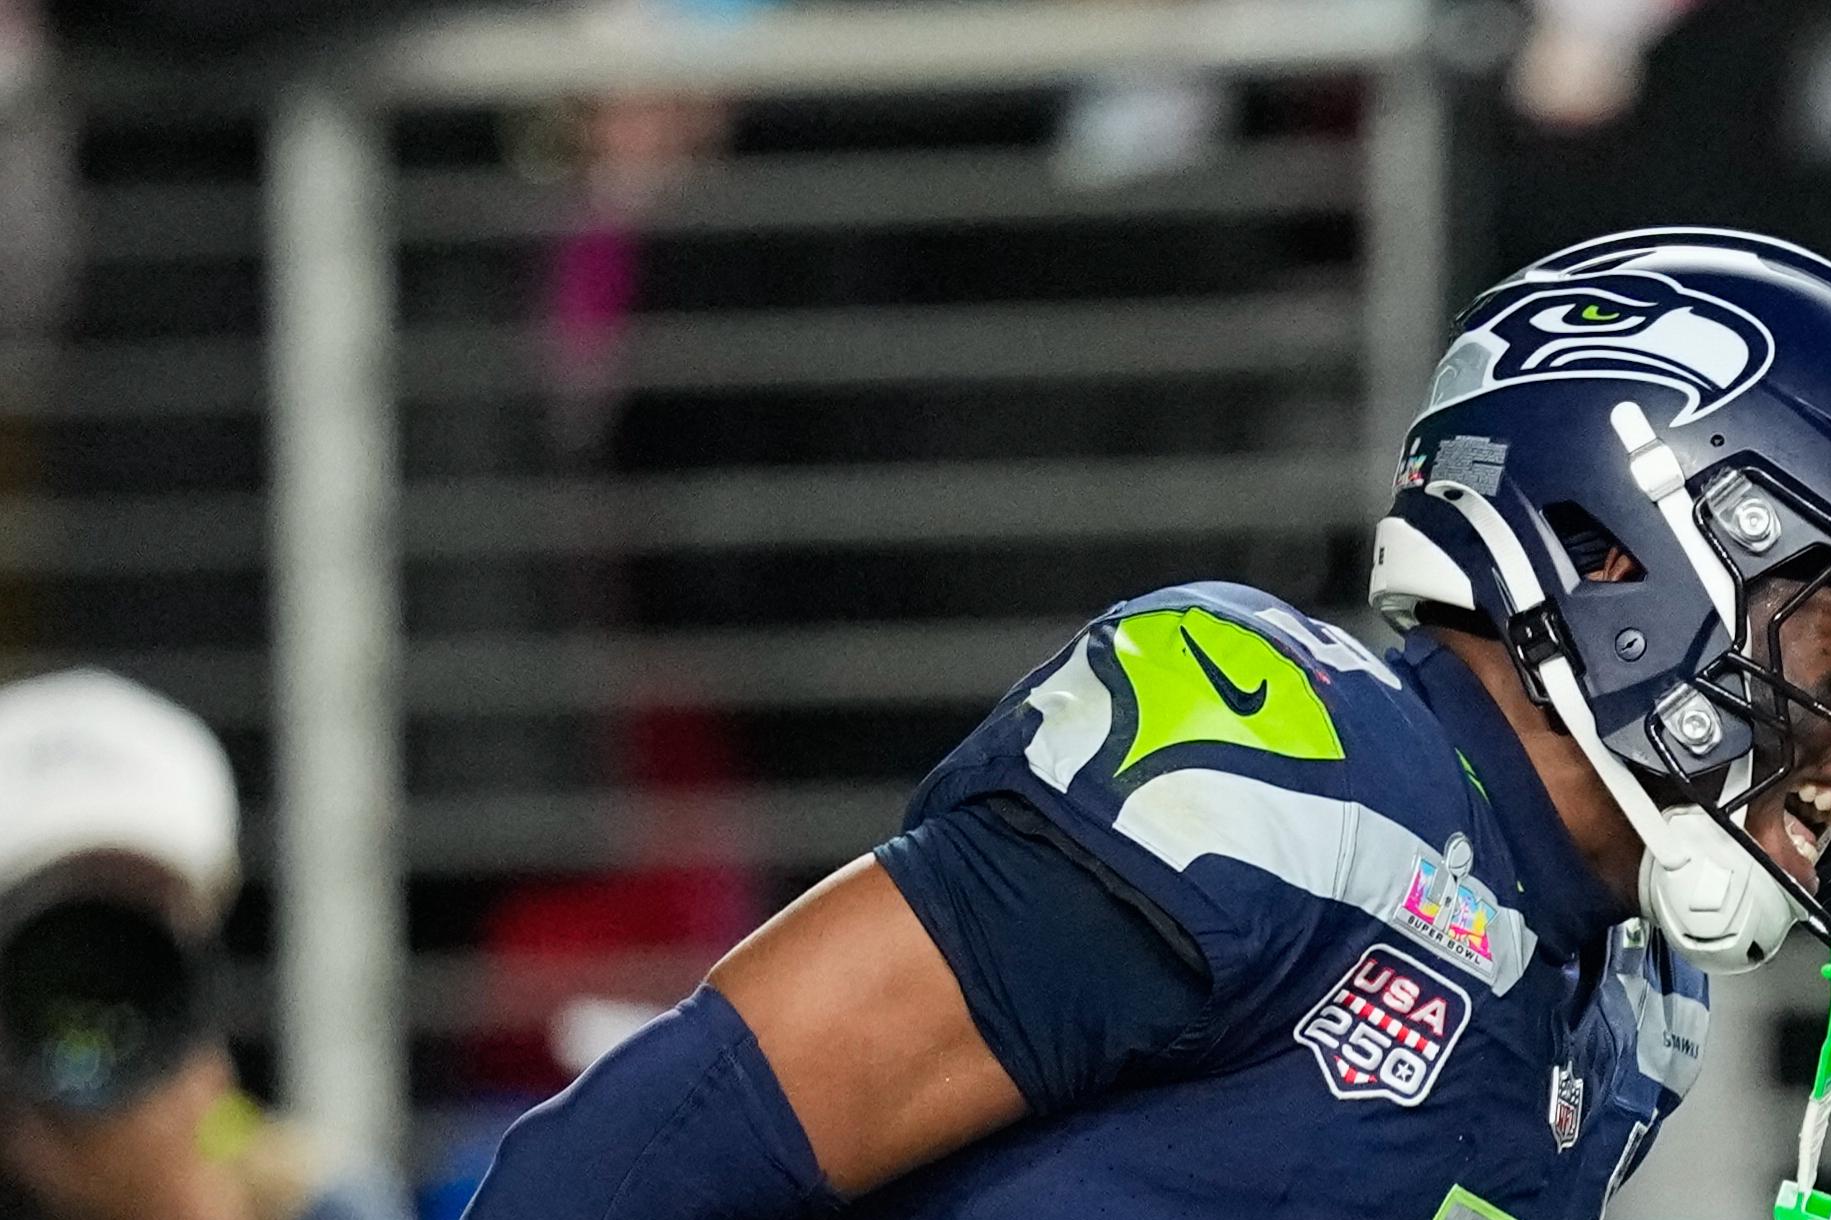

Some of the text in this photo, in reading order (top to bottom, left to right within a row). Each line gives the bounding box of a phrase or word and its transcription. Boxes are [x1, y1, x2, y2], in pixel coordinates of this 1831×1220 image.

[1407, 915, 1481, 965] SUPER BOWL
[1353, 957, 1448, 1037] USA
[1303, 1004, 1427, 1095] 250
